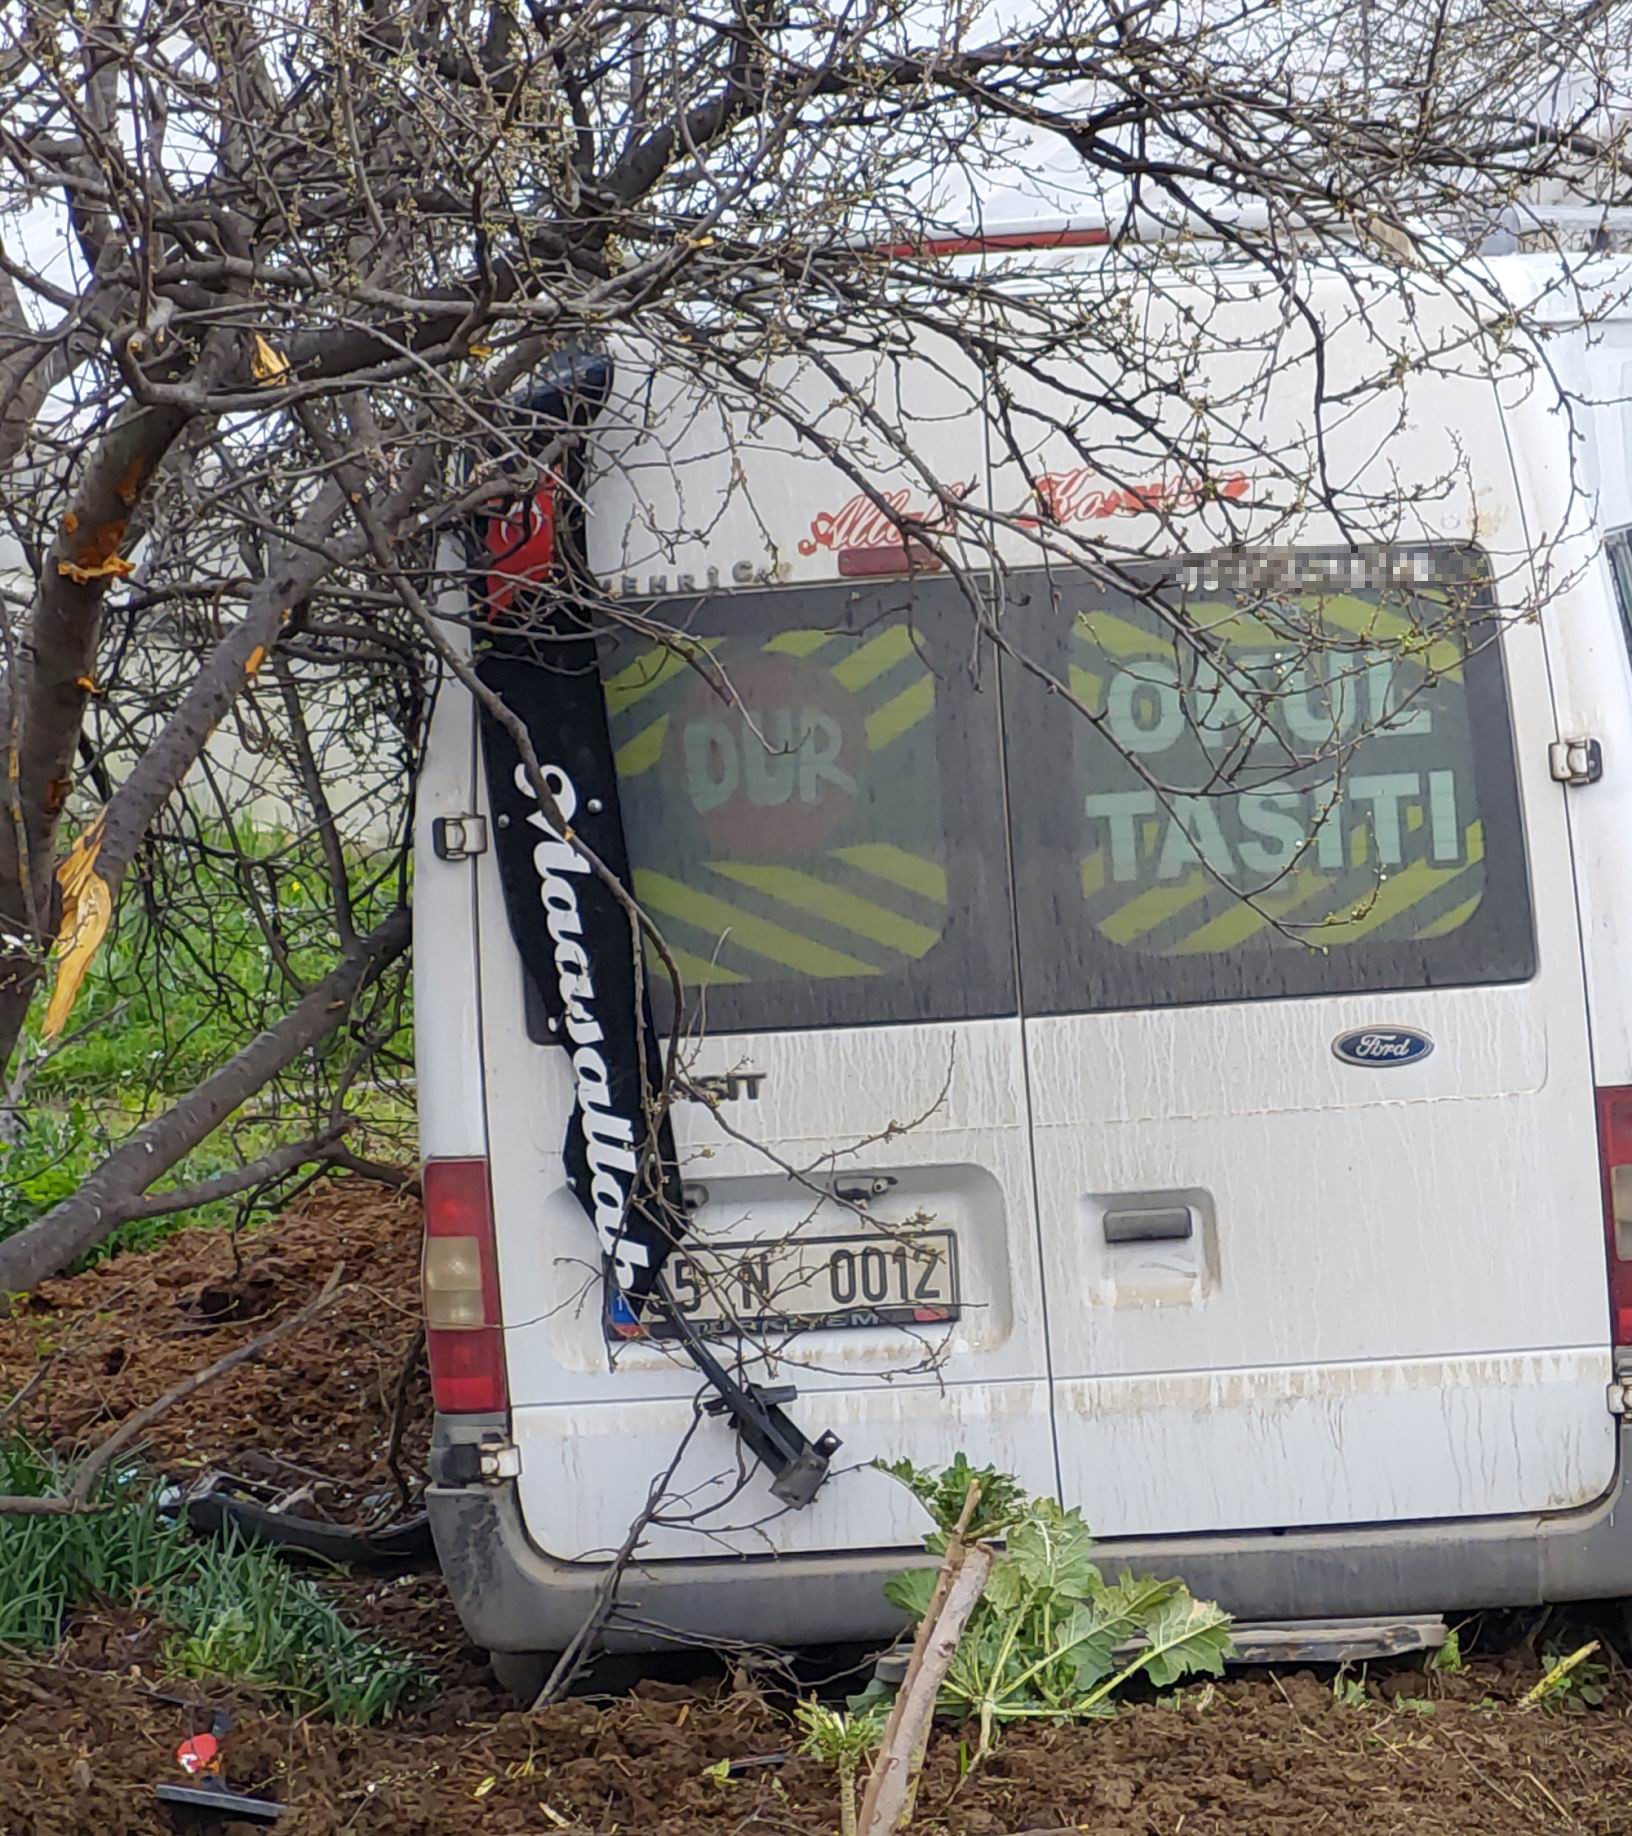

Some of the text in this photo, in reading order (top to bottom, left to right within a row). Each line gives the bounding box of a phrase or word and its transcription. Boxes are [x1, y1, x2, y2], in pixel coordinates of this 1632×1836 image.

[1107, 648, 1433, 754] OKUL
[683, 706, 859, 815] DUR
[1355, 1033, 1413, 1058] Ford
[829, 1244, 941, 1305] 0012
